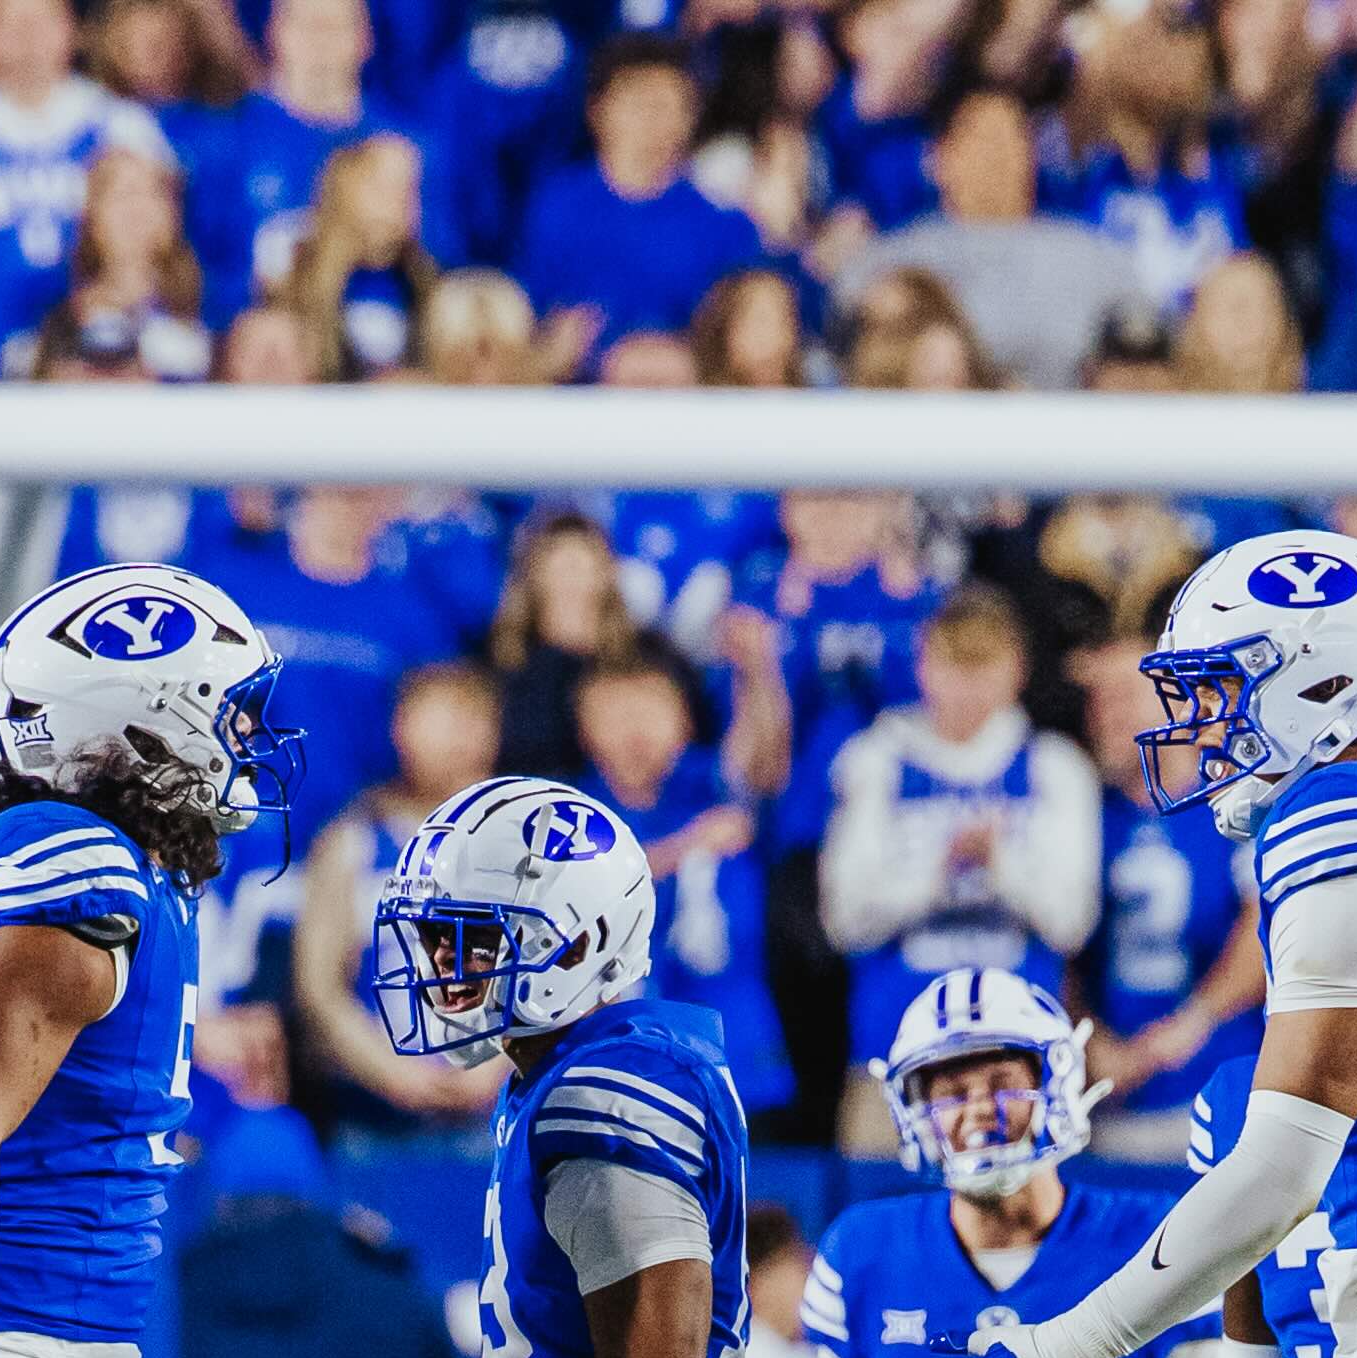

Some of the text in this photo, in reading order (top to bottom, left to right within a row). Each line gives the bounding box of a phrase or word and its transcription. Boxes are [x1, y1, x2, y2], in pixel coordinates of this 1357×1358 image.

[1260, 556, 1342, 603] Y
[95, 600, 175, 656] Y
[531, 804, 598, 853] Y
